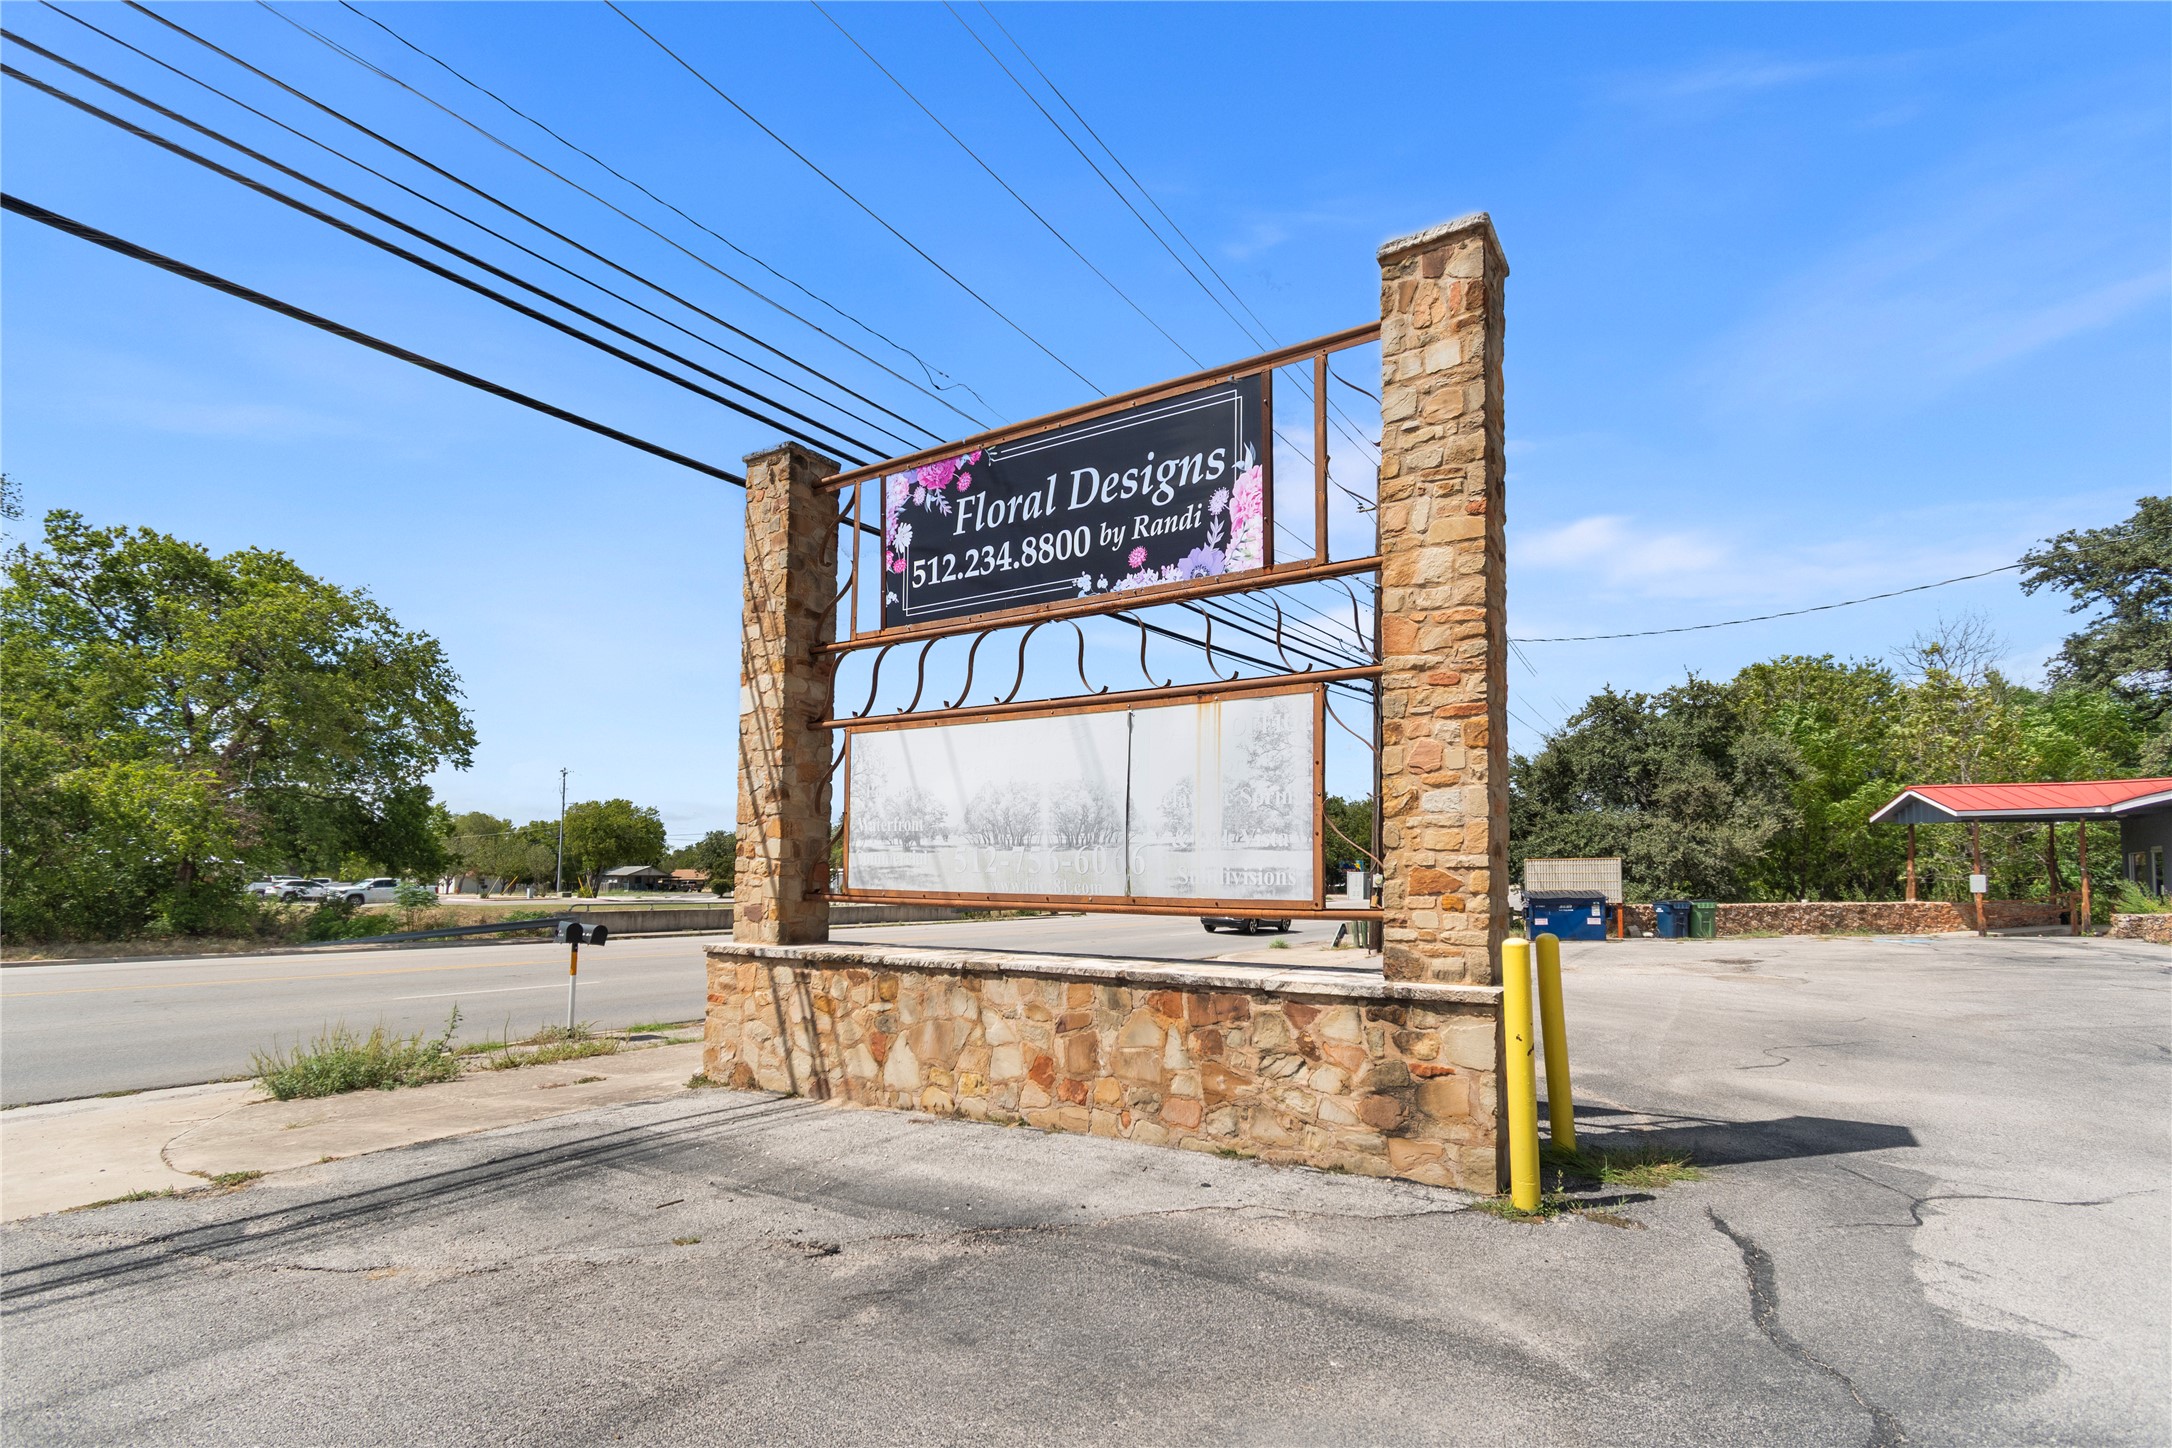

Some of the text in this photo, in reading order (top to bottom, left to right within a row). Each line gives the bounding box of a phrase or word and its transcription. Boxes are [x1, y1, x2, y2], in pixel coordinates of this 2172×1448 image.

[953, 447, 1226, 536] Floral Designs
[1099, 503, 1203, 552] by Randi
[912, 525, 1091, 589] 512.234.8800
[857, 816, 924, 832] Waterfront
[1177, 865, 1297, 886] Suivisions
